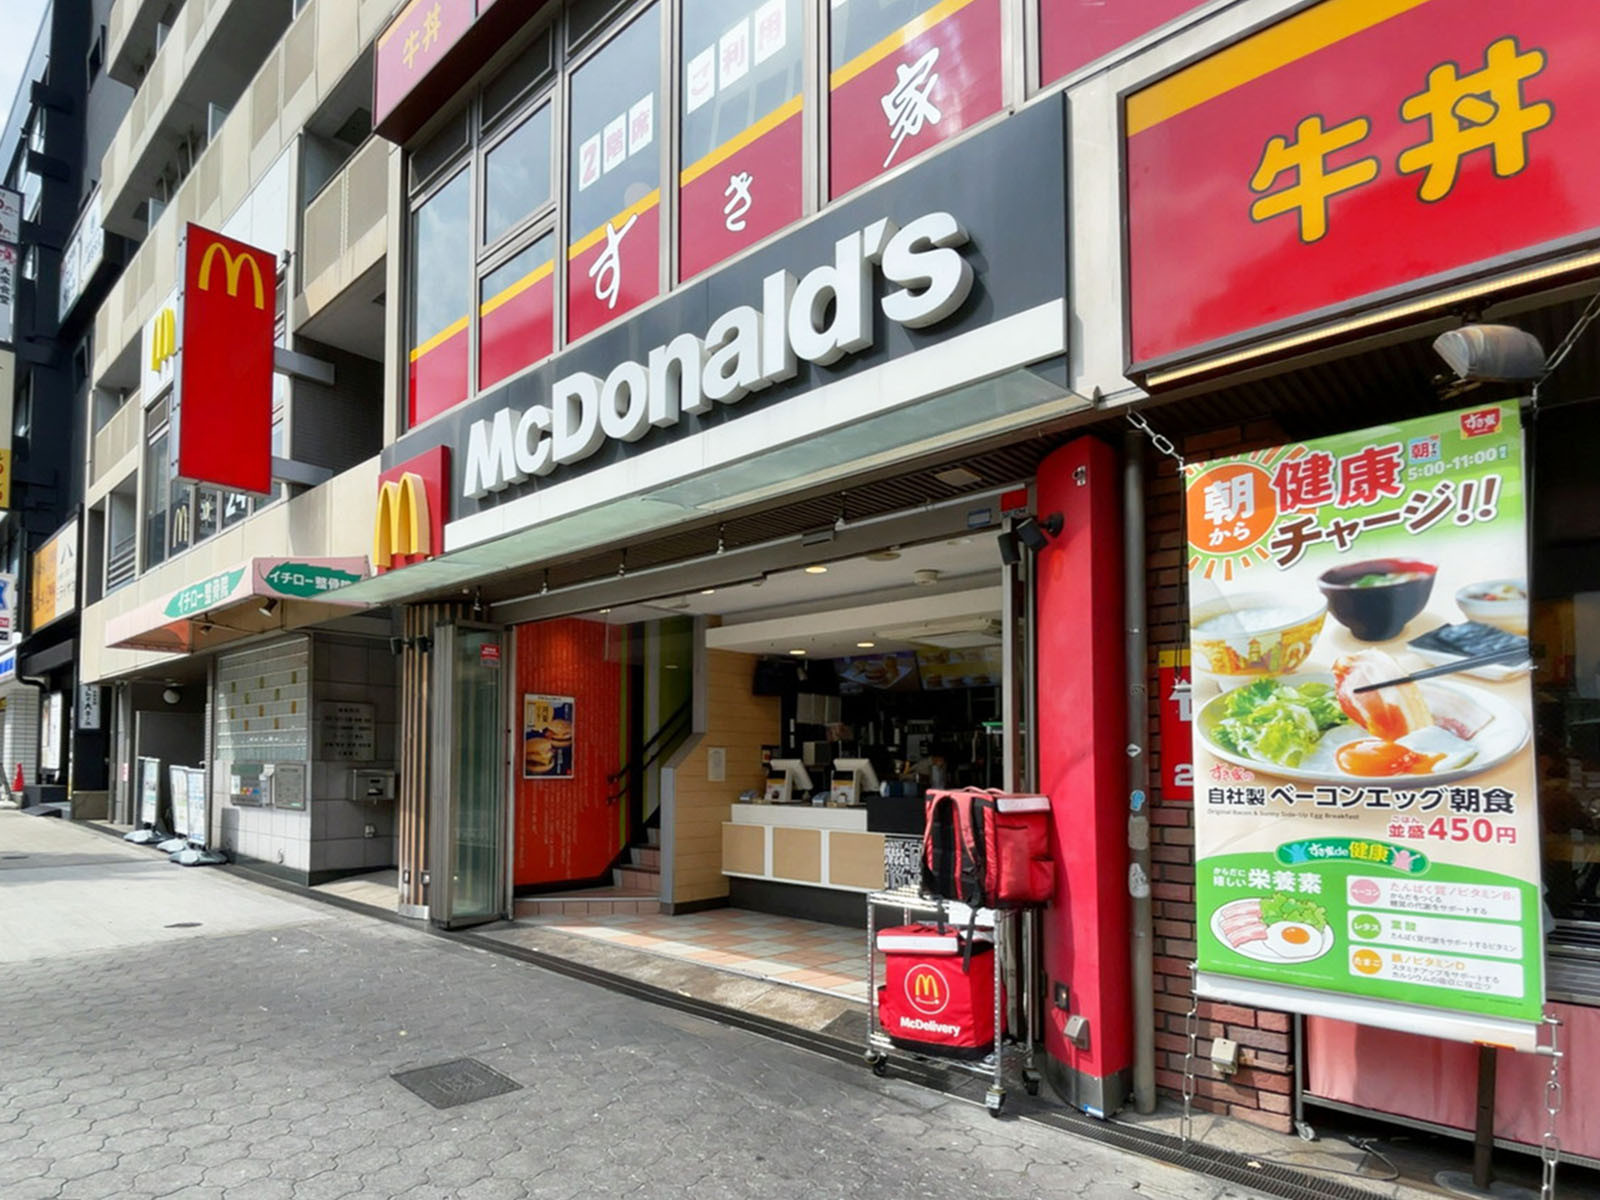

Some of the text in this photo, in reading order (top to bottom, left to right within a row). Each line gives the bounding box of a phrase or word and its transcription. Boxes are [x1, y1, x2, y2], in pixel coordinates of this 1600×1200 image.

[402, 8, 442, 69] 牛丼
[1249, 35, 1555, 244] 牛丼
[463, 211, 975, 501] McDonald's
[1273, 446, 1404, 513] 健康
[1407, 447, 1498, 480] 5:00-11:00
[1203, 472, 1255, 526] 朝
[1208, 521, 1251, 546] から
[1271, 477, 1498, 567] チャージ!!
[1208, 785, 1515, 814] 自社製 ベーコンエッグ朝食
[1428, 818, 1517, 844] 450円
[1248, 868, 1322, 894] 栄養素
[1354, 922, 1381, 932] レタス
[900, 1016, 960, 1037] McDelivery
